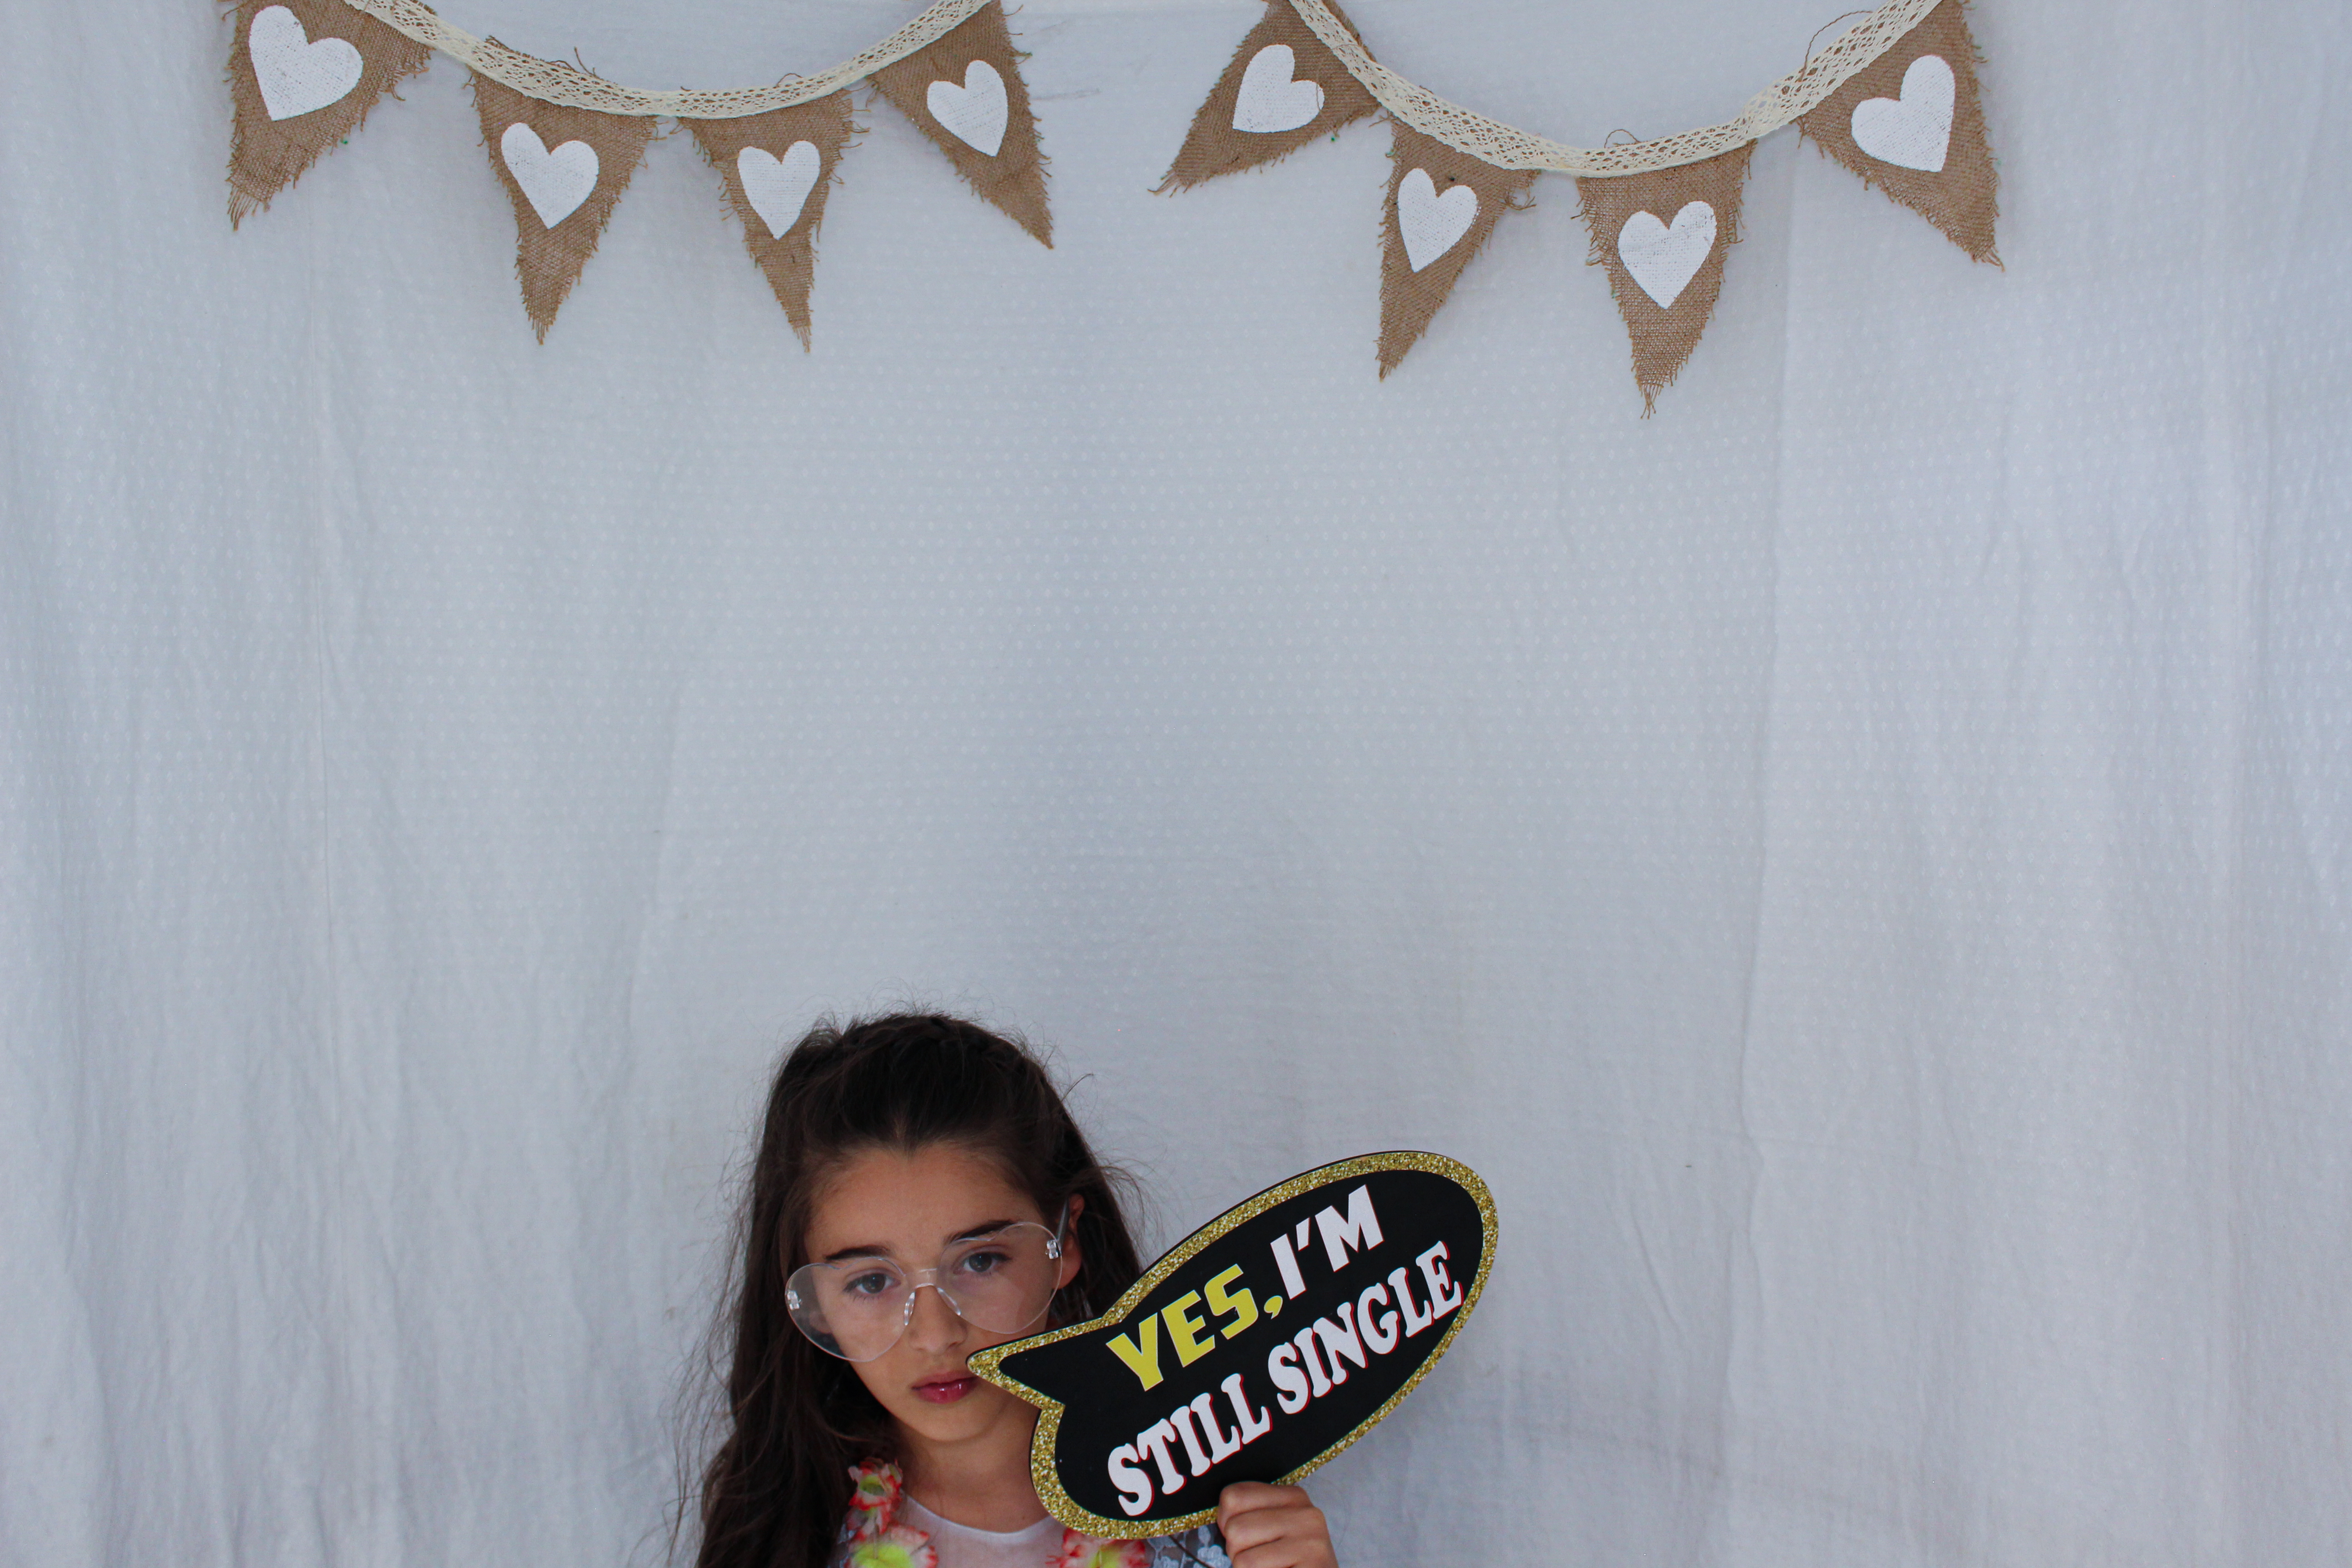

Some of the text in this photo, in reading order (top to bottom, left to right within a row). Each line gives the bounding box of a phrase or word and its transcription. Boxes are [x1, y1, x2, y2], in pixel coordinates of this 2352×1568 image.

[1106, 1185, 1384, 1392] YES, I'M
[1107, 1241, 1463, 1516] STILL SINGLE
